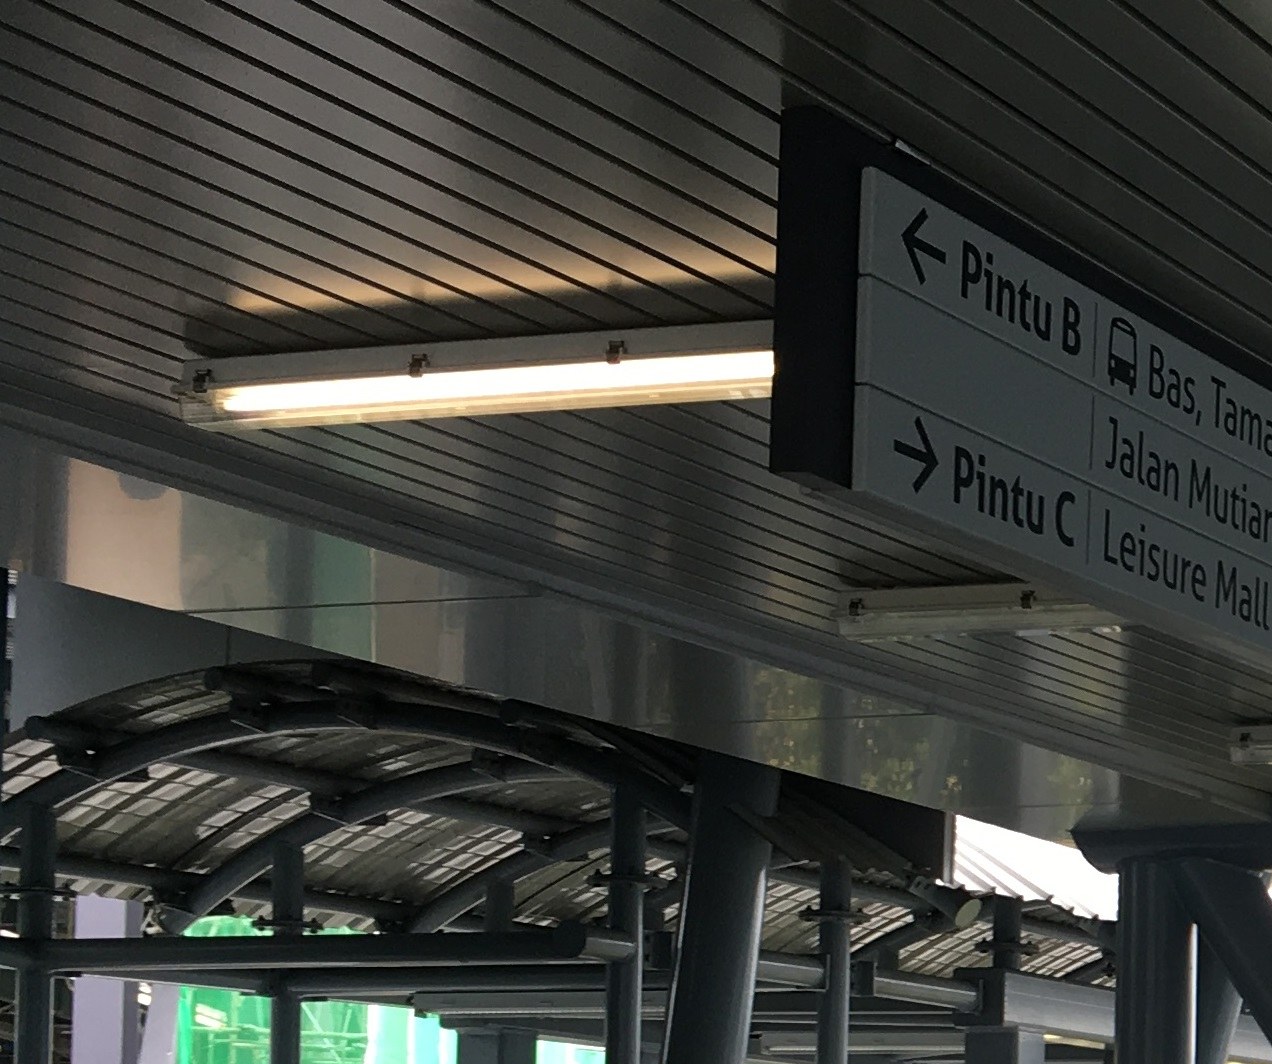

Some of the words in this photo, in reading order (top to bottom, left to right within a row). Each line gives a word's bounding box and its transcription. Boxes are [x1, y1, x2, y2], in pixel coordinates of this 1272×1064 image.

[961, 241, 1052, 342] Pintu
[1062, 298, 1081, 356] B
[1147, 343, 1201, 426] Bas,
[953, 445, 1046, 534] Pintu
[1054, 491, 1076, 548] C
[1105, 416, 1180, 502] Jalan
[1103, 509, 1207, 603] Leisure
[1215, 559, 1271, 632] Mall
